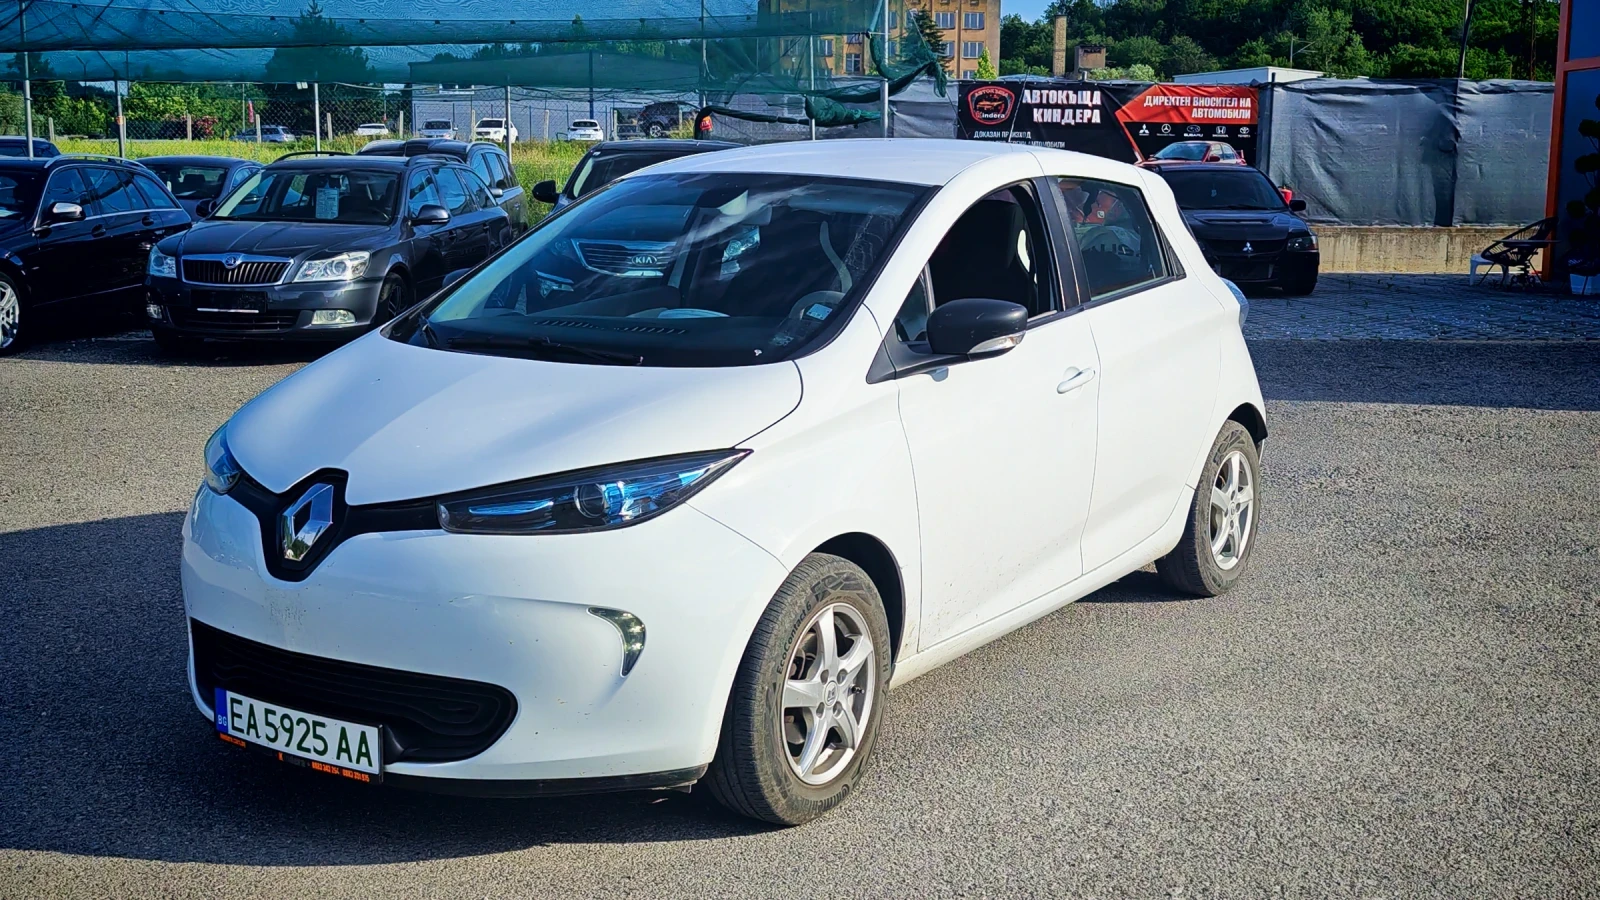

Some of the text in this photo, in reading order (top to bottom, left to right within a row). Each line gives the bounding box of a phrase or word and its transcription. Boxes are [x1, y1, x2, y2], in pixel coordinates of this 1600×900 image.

[1022, 89, 1102, 107] АВТОКЪЩА
[1144, 95, 1252, 108] ДИРЕКТЕН ВНОСИТЕЛ НА
[1033, 108, 1101, 126] КИНДЕРА
[1191, 108, 1251, 119] АВТОМОБИЛИ
[973, 130, 1001, 139] ДОКАЗАН
[635, 256, 653, 264] KIA
[217, 714, 228, 727] BG
[229, 696, 373, 768] EA 5925 AA
